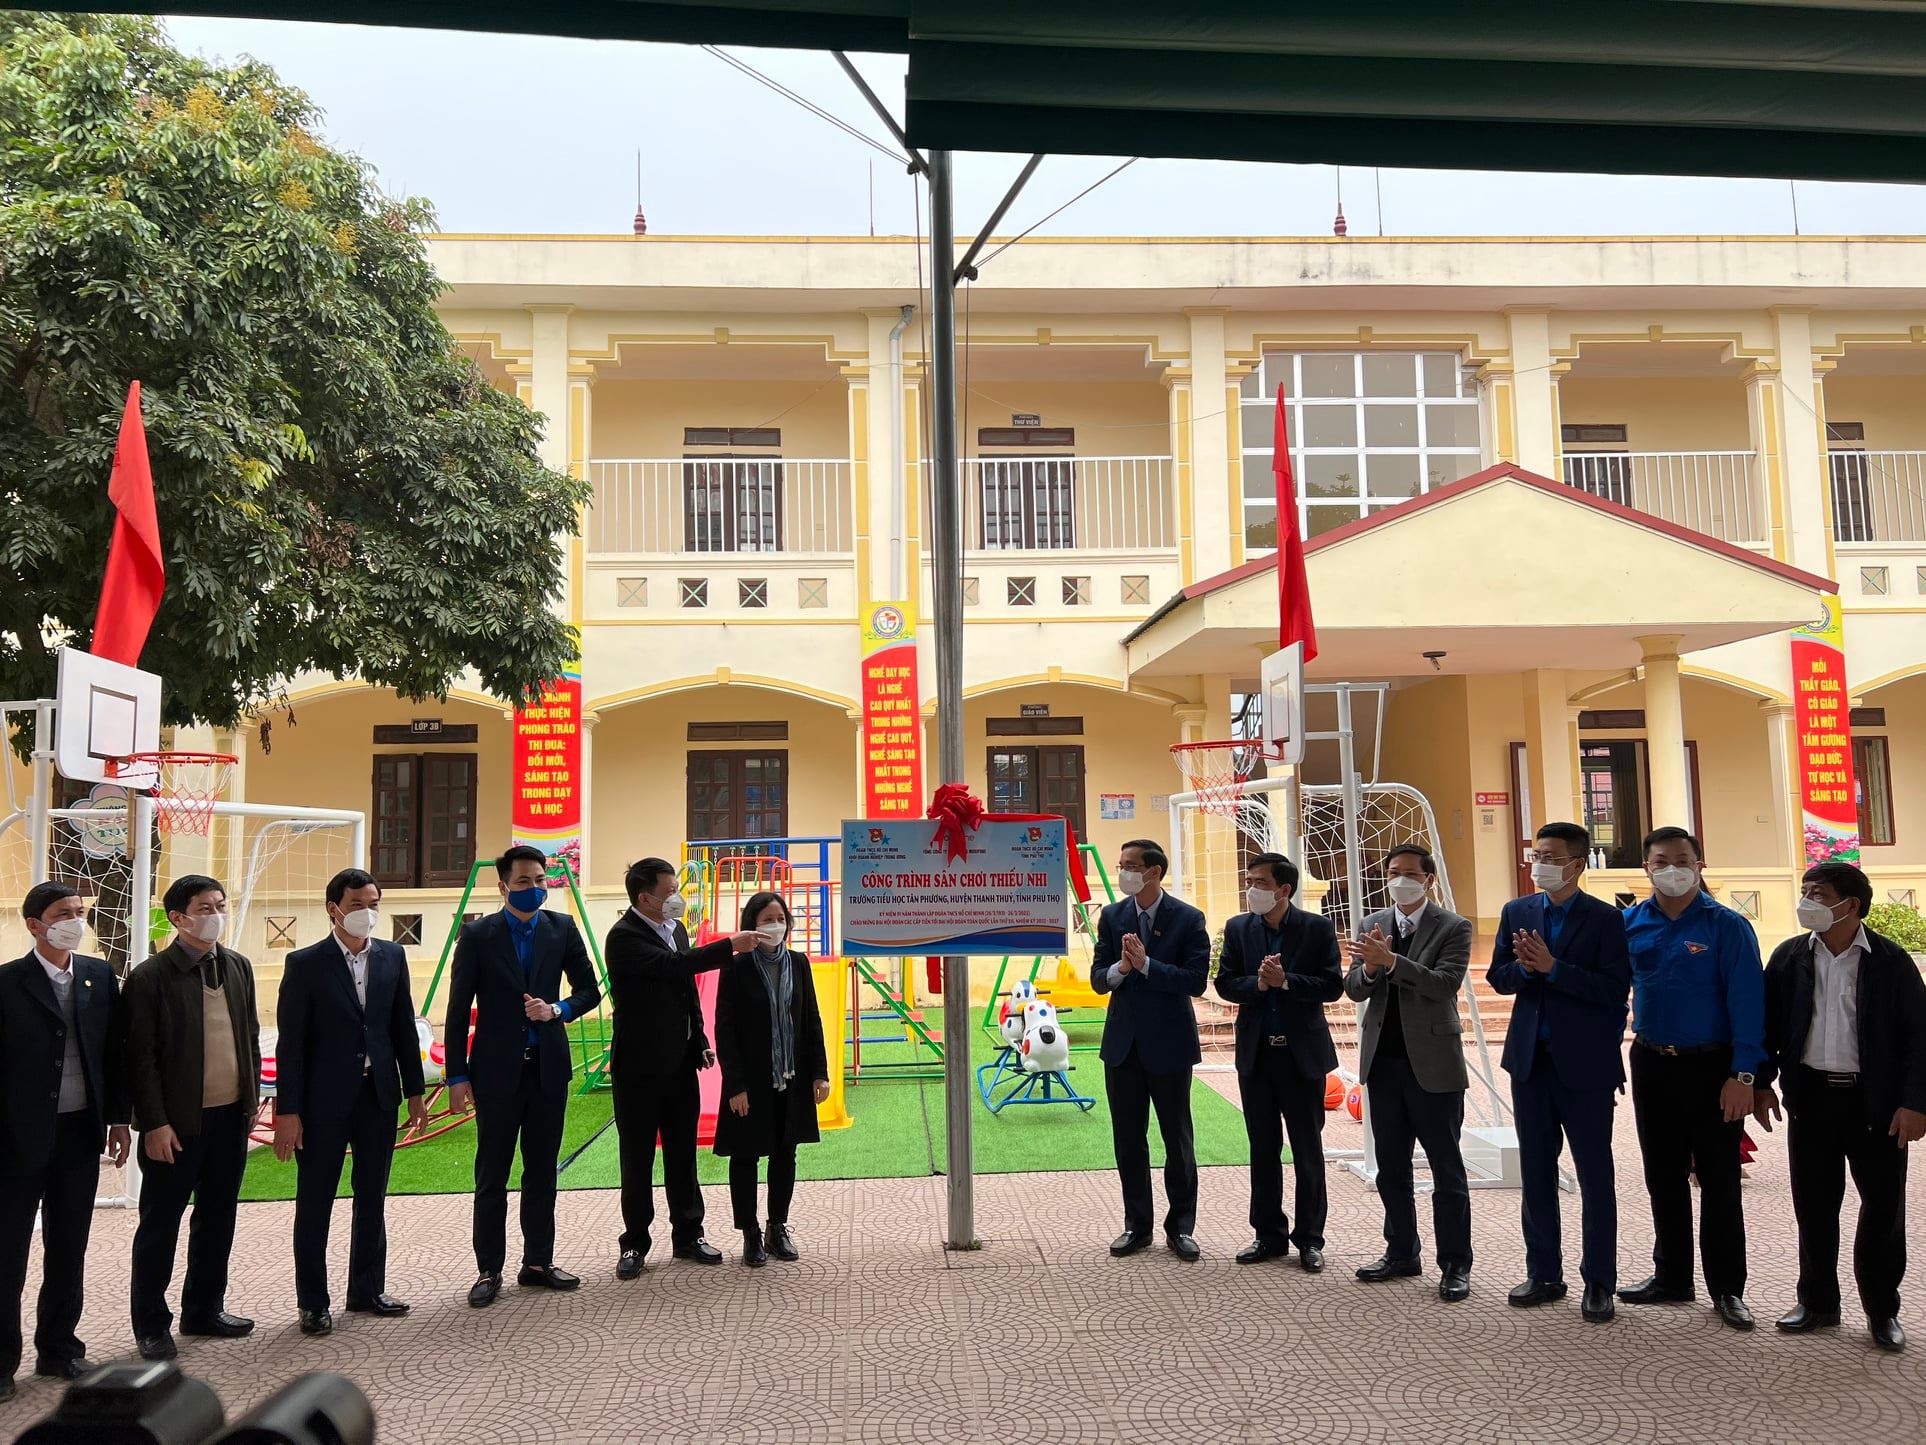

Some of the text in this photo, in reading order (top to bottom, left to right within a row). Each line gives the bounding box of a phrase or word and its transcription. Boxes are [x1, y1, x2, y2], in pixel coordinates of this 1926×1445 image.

[886, 667, 897, 680] DẠY
[898, 667, 911, 680] HỌC
[878, 681, 885, 695] LÀ
[1820, 678, 1841, 692] GIÁO,
[544, 692, 572, 704] MẠNH
[870, 700, 882, 712] CAO
[896, 696, 912, 710] NHẤT
[1808, 696, 1838, 710] CÔ GIÁO
[524, 706, 570, 721] THỰC HIỆN
[871, 713, 912, 728] TRONG NHỮNG
[414, 720, 428, 730] LỚP
[519, 722, 576, 735] PHONG TRÀO
[1809, 714, 1837, 730] LÀ MỘT
[528, 740, 566, 751] THI ĐUA:
[887, 733, 900, 744] CAO
[1802, 732, 1847, 747] TẤM GƯƠNG
[545, 753, 567, 767] MỚI,
[886, 747, 903, 760] SÁNG
[904, 749, 916, 762] TẠO
[1809, 750, 1842, 768] ĐẠO ĐỨC
[524, 770, 569, 784] SÁNG TẠO
[874, 763, 912, 778] NHẤT TRONG
[1808, 769, 1847, 786] TỰ HỌC VÀ
[522, 787, 572, 800] TRONG DẠY
[874, 780, 896, 794] NHỮNG
[1810, 787, 1848, 804] SÁNG TẠO
[530, 802, 564, 816] VÀ HỌC
[880, 798, 909, 812] SÁNG TẠO
[862, 867, 1048, 888] CÔNG TRÌNH SÂN CHƠI THIẾU NHI
[848, 894, 876, 904] TRƯỜNG
[892, 895, 906, 906] HỌC
[906, 894, 920, 904] TÂN
[920, 894, 950, 905] PHƯƠNG,
[950, 893, 972, 905] HUYỆN
[974, 894, 995, 904] THANH
[1048, 894, 1060, 905] THỌ
